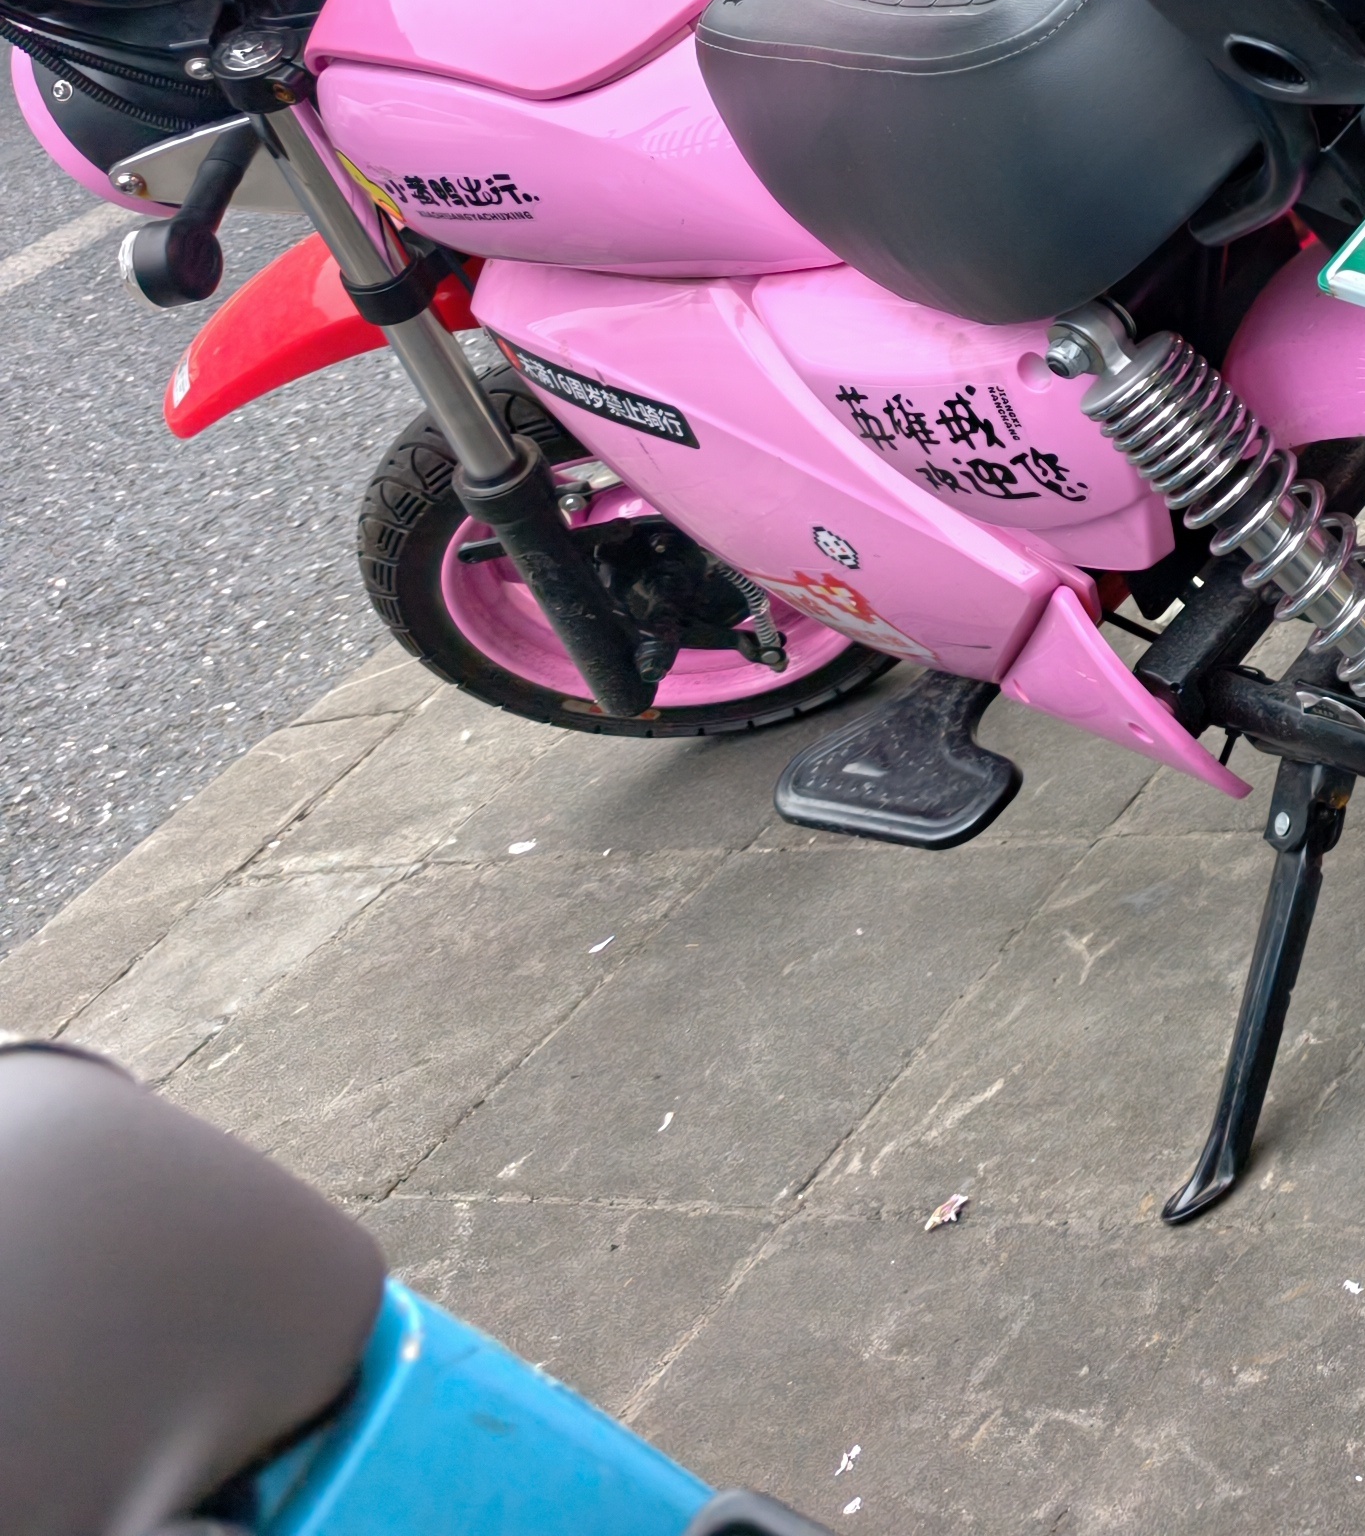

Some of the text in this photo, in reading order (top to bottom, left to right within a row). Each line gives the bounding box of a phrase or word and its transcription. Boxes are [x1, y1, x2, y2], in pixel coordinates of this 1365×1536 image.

[516, 353, 684, 437] 未满16周岁禁止骑行
[836, 385, 1006, 455] 英雄城
